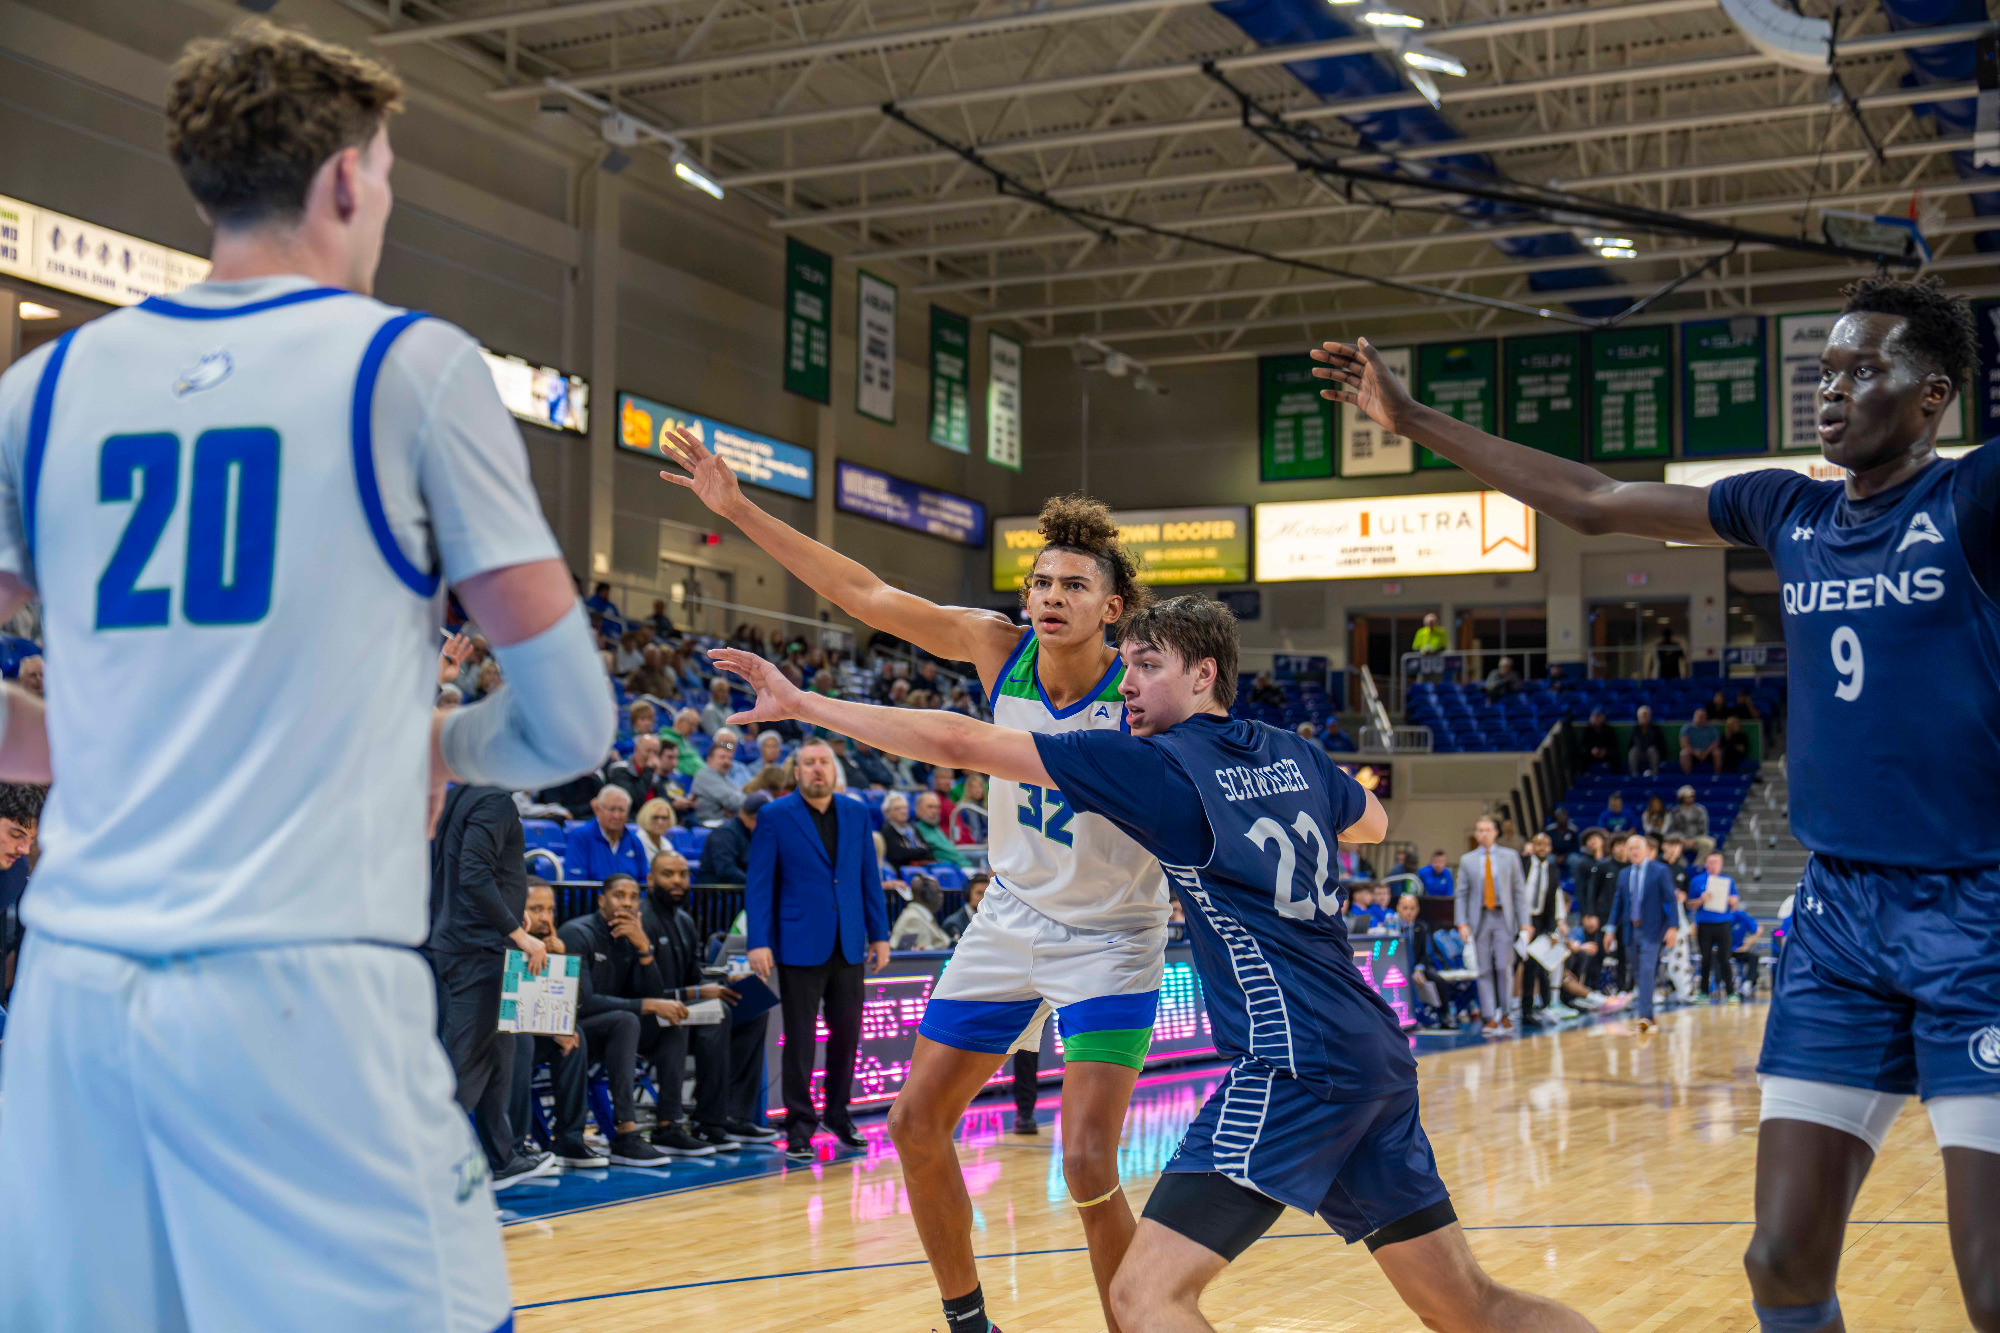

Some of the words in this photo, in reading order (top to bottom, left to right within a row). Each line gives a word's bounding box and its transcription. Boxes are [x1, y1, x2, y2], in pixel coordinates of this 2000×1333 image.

[94, 426, 281, 632] 20
[1163, 519, 1236, 542] ROOFER
[1378, 510, 1473, 535] ULTRA
[1783, 566, 1946, 615] QUEENS
[1830, 625, 1865, 702] 9
[1017, 782, 1076, 850] 32
[1243, 810, 1341, 921] 22
